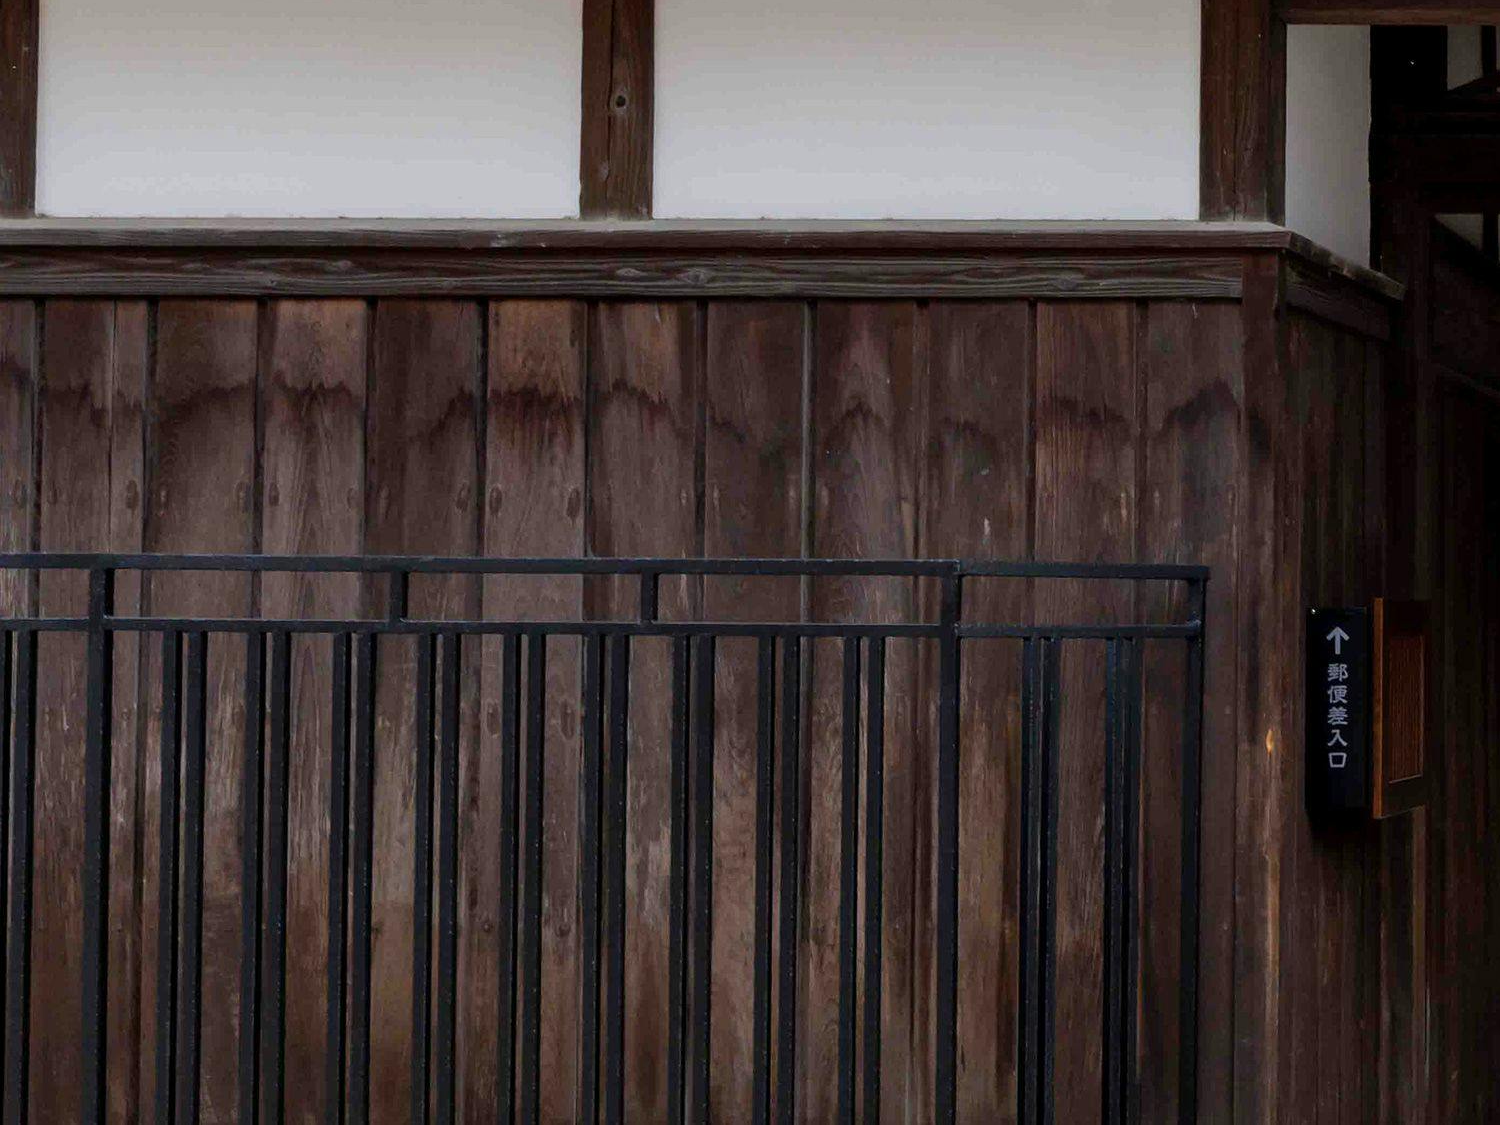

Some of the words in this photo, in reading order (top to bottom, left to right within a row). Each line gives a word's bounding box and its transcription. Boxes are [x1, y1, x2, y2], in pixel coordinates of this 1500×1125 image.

[1327, 663, 1349, 768] 郵便差入口
